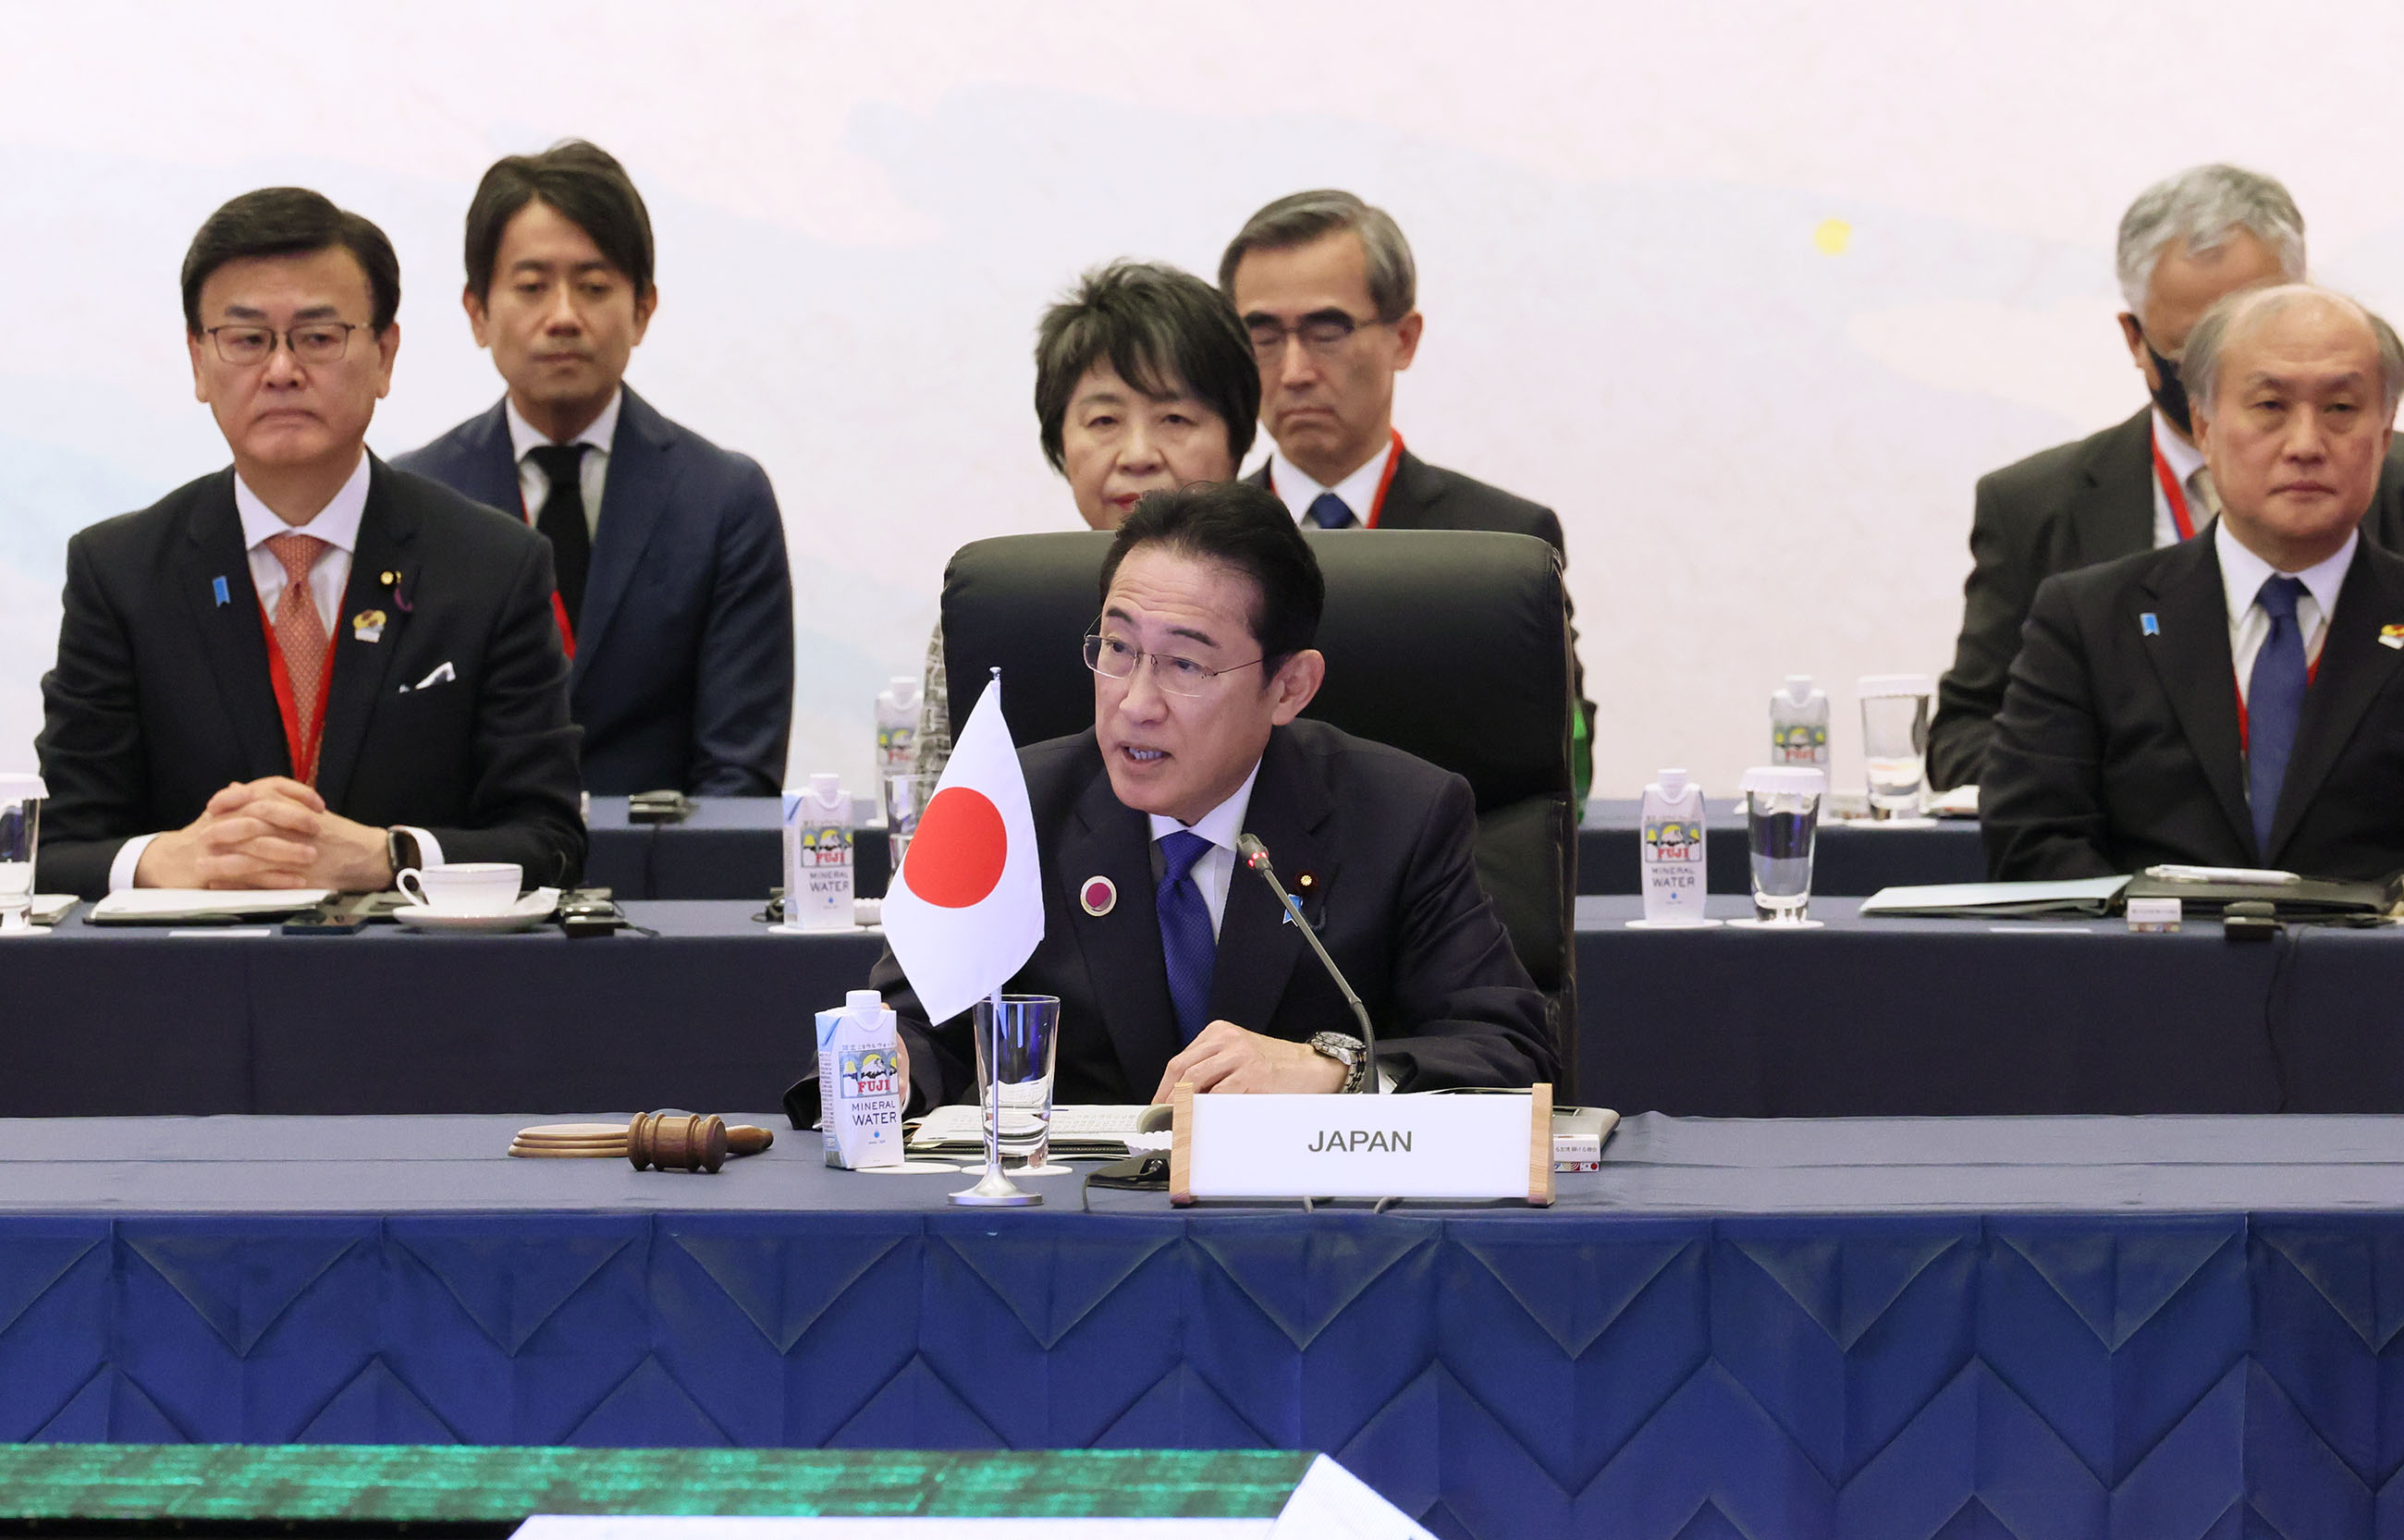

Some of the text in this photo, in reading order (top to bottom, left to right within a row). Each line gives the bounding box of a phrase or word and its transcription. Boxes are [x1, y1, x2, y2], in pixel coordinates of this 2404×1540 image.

[816, 851, 844, 863] FUJI
[1657, 847, 1688, 859] FUJI
[810, 880, 850, 892] WATER
[1652, 876, 1695, 887] WATER
[858, 1079, 890, 1093] FUJI
[852, 1100, 896, 1112] MINERAL
[852, 1111, 897, 1127] WATER
[1307, 1131, 1412, 1152] JAPAN
